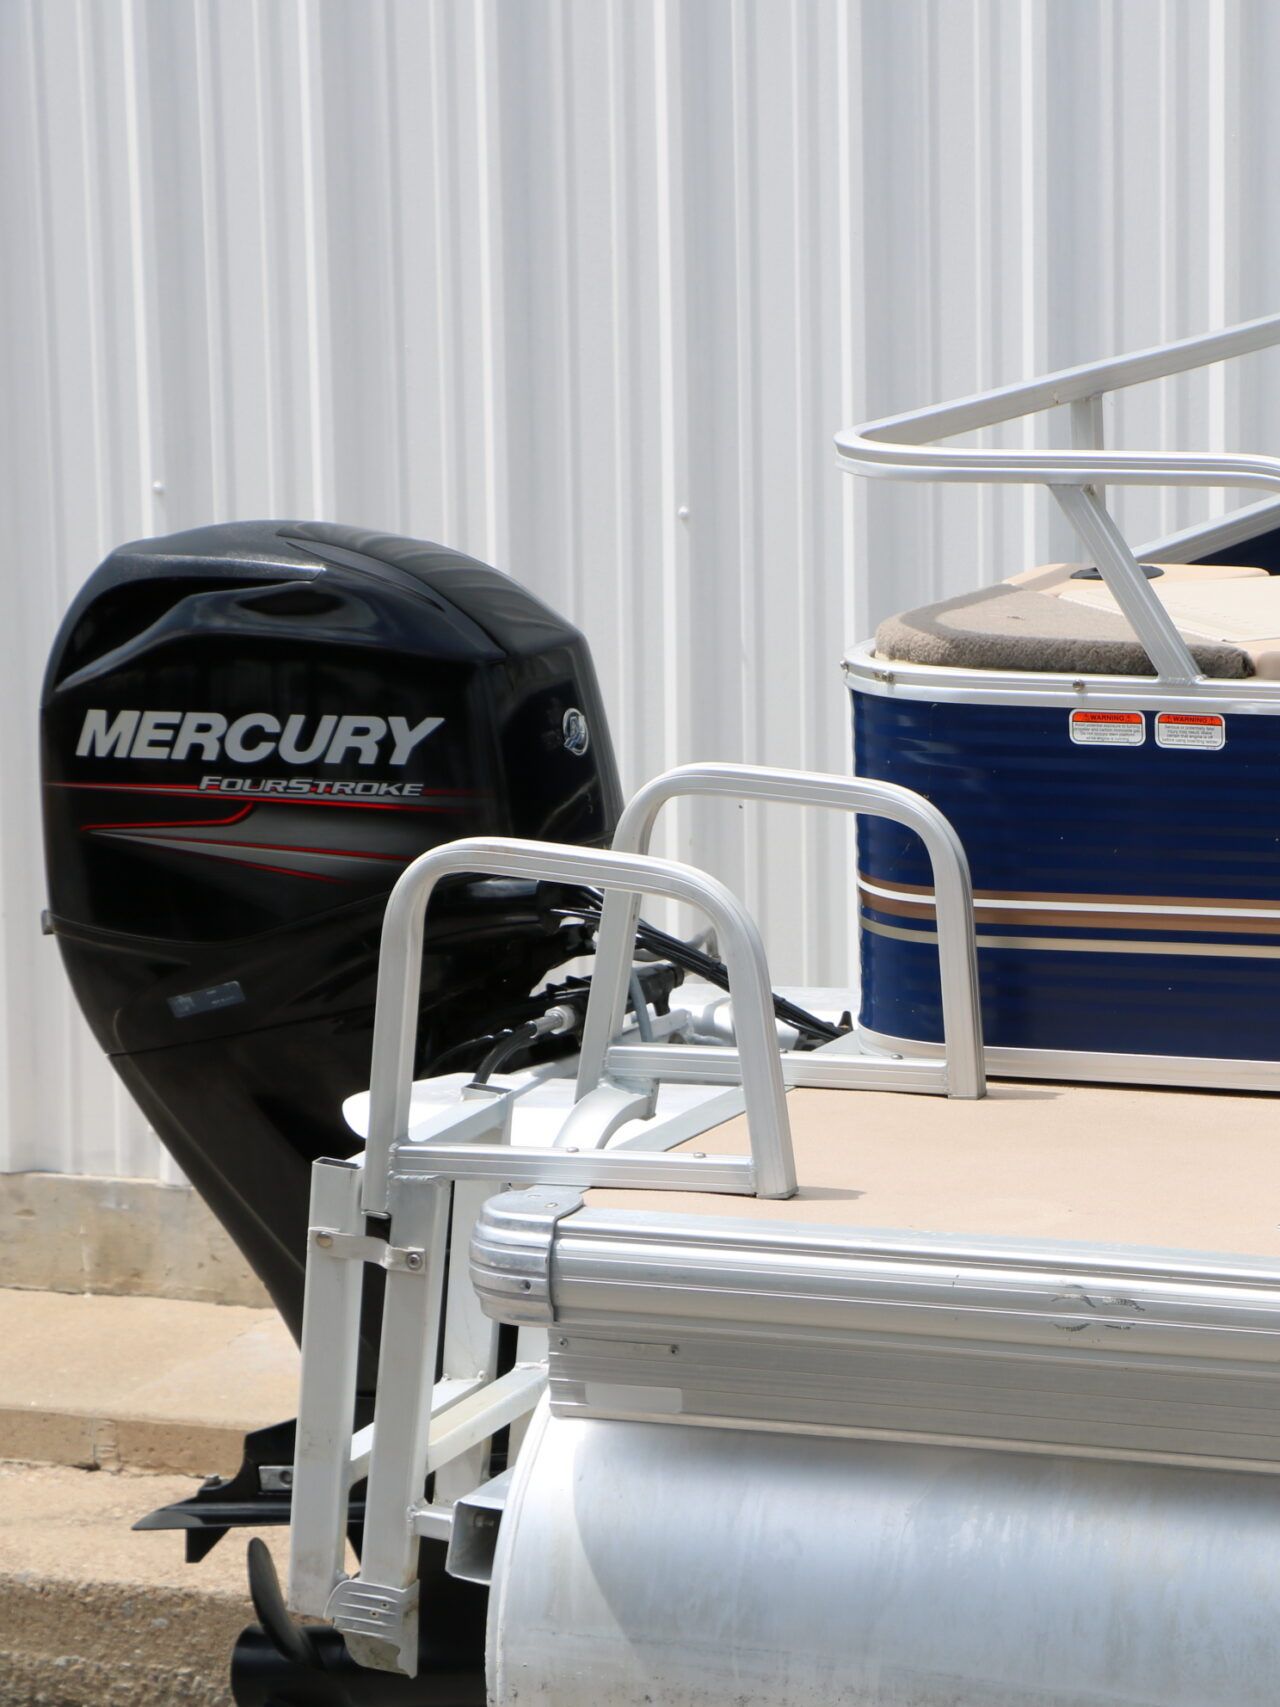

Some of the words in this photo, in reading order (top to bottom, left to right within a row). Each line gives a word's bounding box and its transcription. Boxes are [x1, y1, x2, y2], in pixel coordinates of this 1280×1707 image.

[1089, 714, 1125, 722] WARNING
[1172, 716, 1209, 724] WARNING
[75, 709, 446, 766] MERCURY
